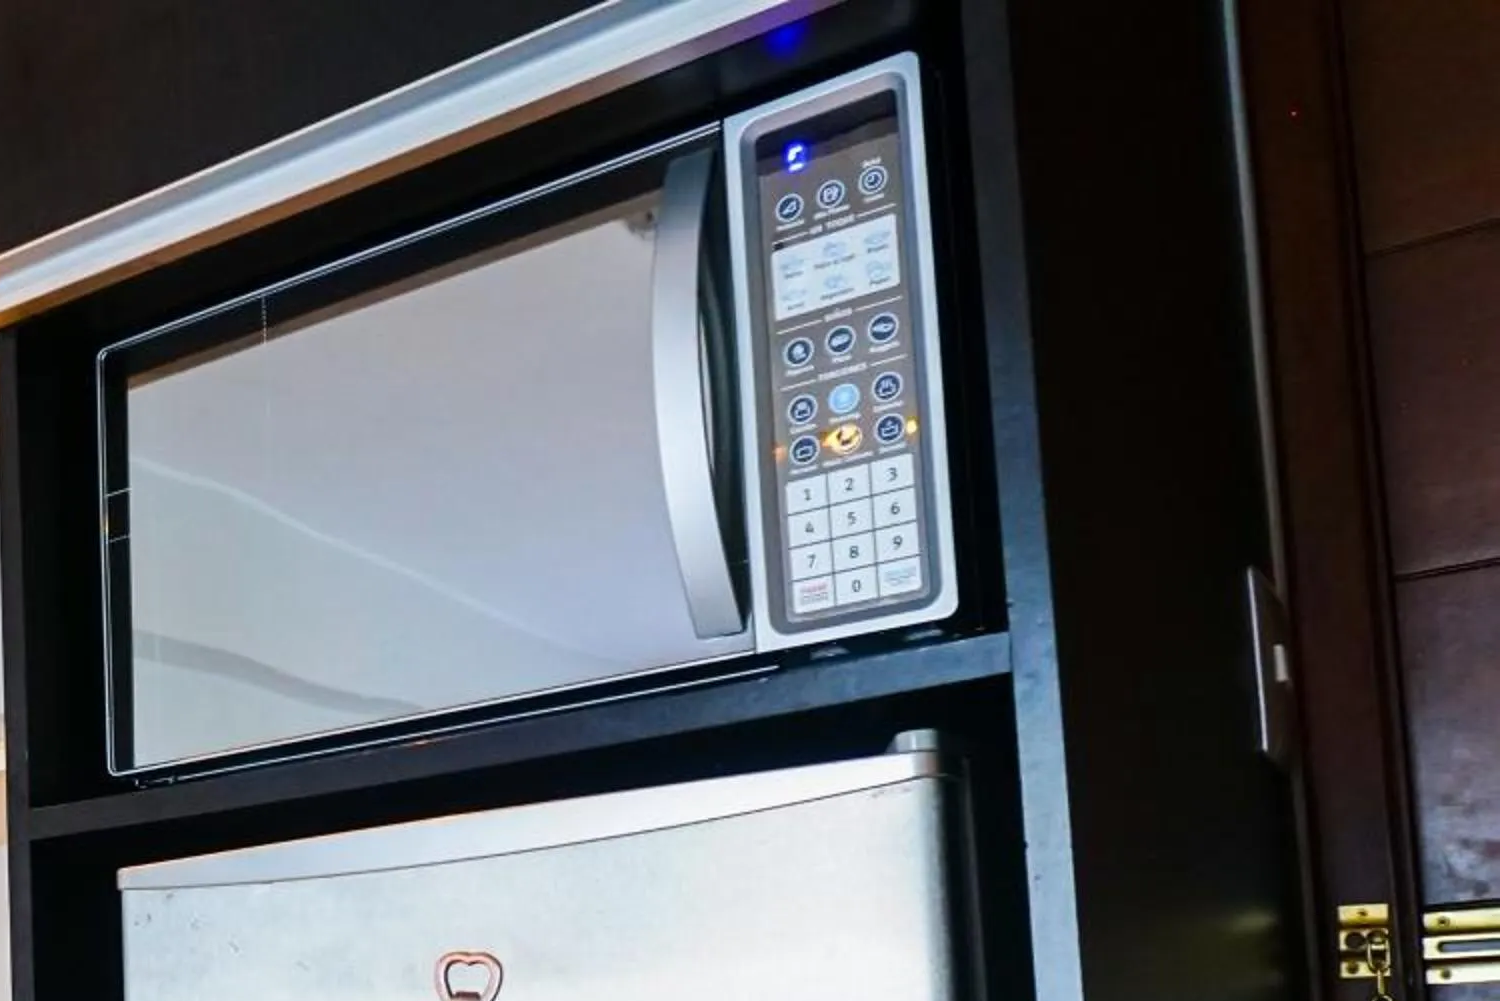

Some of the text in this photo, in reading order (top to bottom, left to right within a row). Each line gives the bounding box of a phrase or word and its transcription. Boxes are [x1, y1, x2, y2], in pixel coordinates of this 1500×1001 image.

[803, 466, 898, 502] 1 2 3
[804, 501, 901, 534] 4 5 6
[806, 535, 903, 569] 7 8 9
[851, 579, 862, 593] 0
